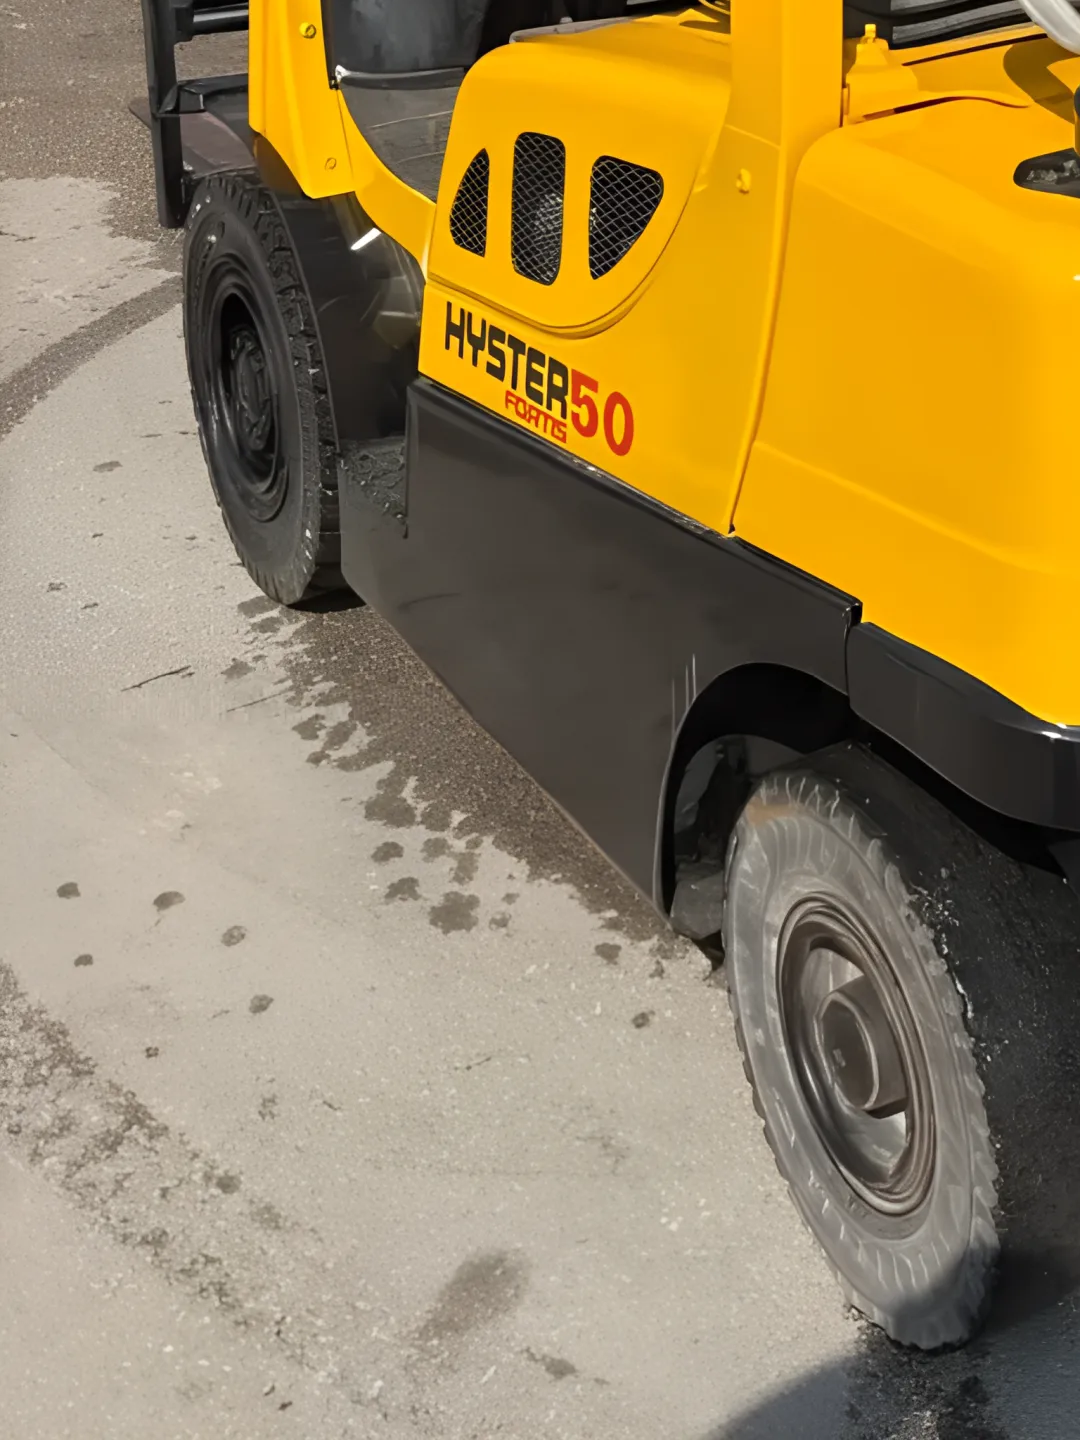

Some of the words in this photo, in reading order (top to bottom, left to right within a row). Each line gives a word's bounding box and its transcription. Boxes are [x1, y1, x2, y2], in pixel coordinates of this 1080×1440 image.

[445, 301, 569, 419] HYSTER
[571, 368, 634, 457] 50
[505, 390, 567, 444] FORTIS
